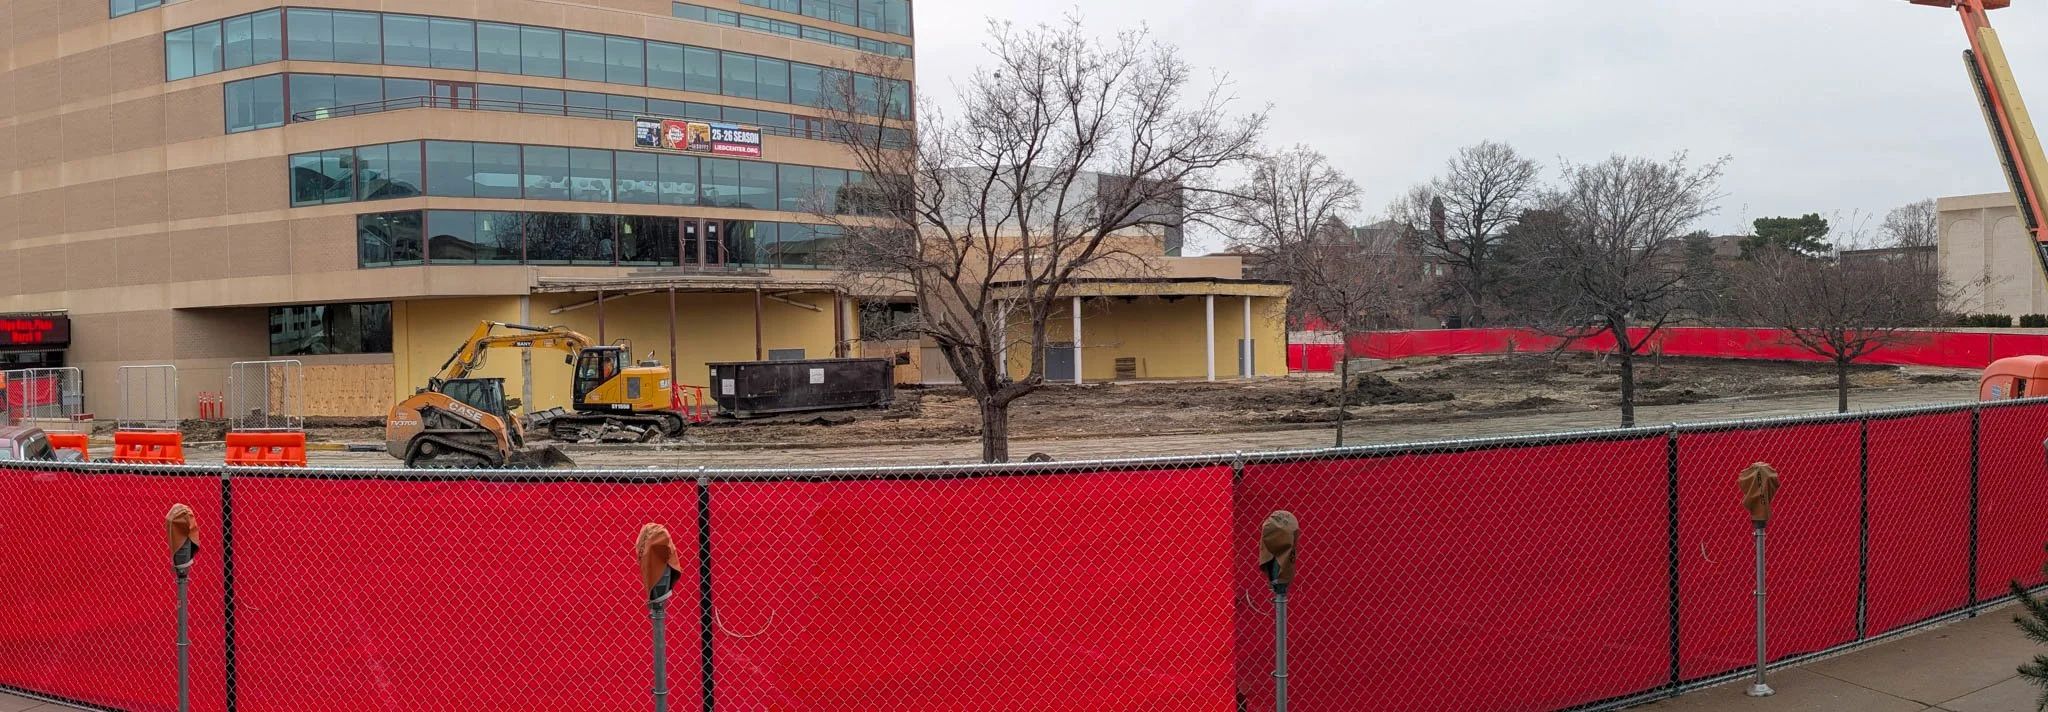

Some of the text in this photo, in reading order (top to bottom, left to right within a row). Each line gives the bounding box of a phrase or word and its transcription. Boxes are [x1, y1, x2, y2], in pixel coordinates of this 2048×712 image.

[712, 129, 759, 144] 25-26 SEASON
[714, 144, 759, 153] LIEDCENTER.ORG
[448, 402, 484, 420] CASE
